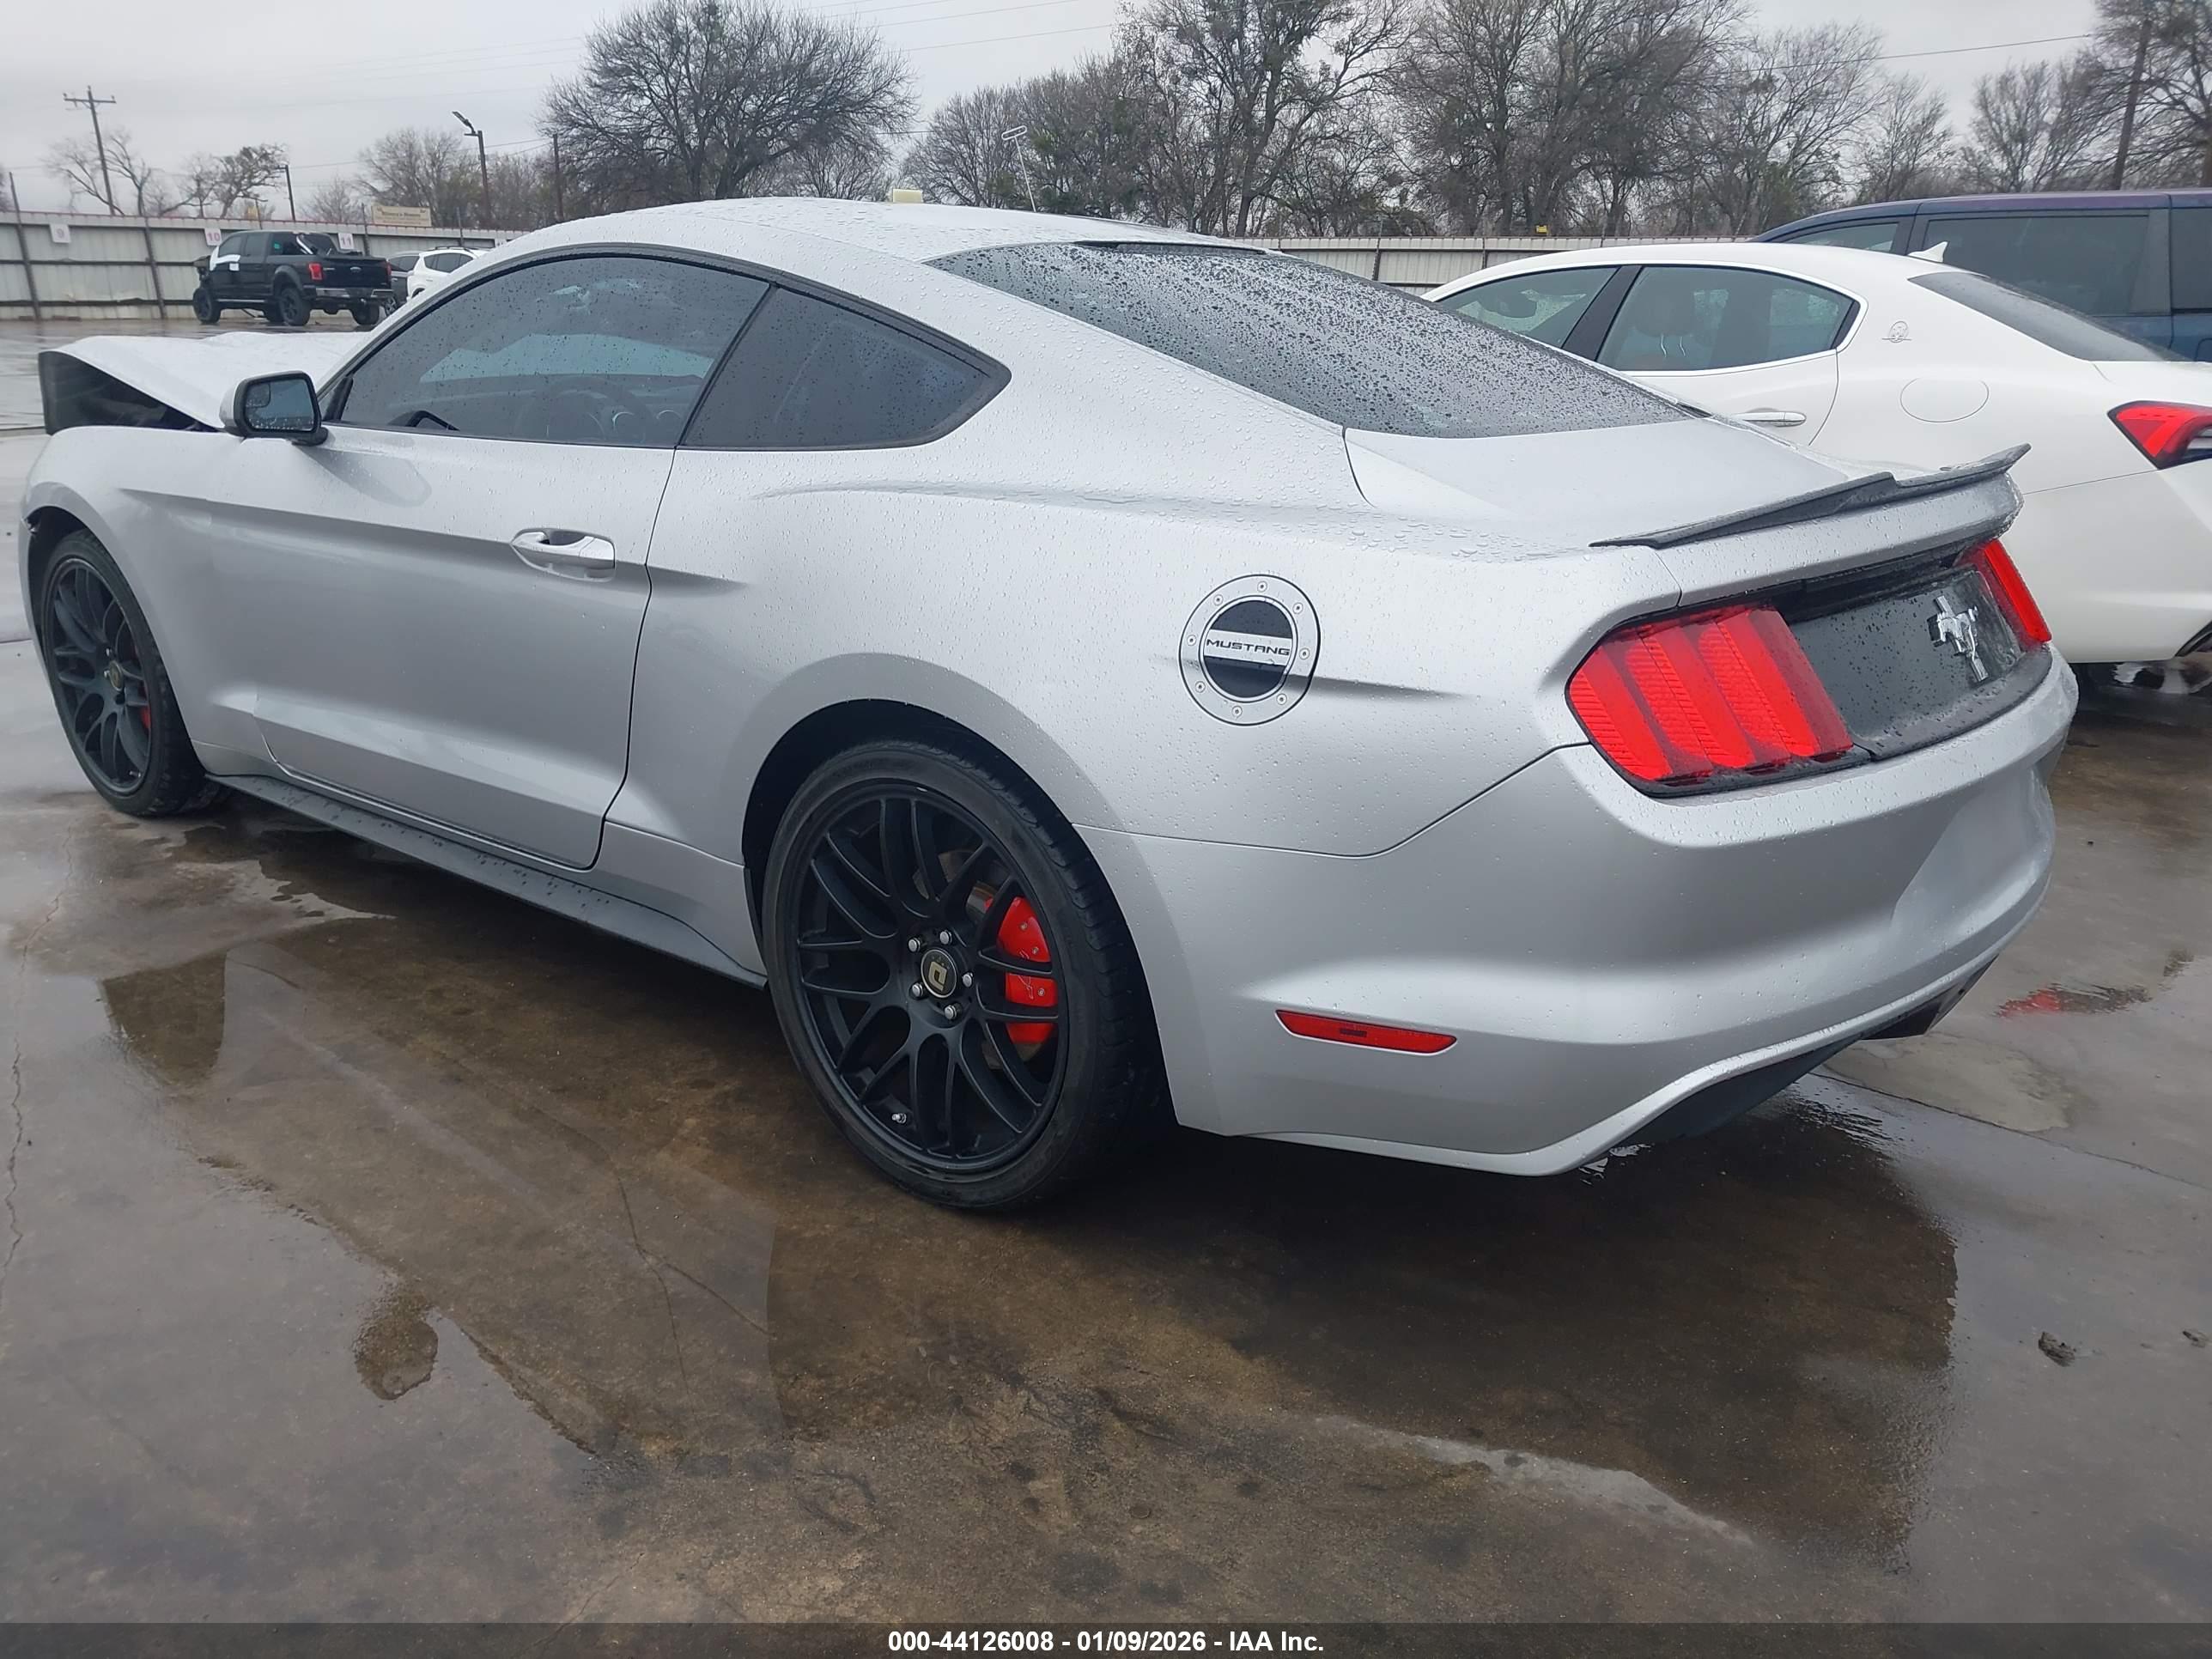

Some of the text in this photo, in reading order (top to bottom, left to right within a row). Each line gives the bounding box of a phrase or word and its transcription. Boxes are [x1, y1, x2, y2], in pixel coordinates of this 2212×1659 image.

[56, 228, 65, 240] 9
[206, 232, 221, 241] 10
[340, 236, 351, 246] 11
[1206, 638, 1291, 656] MUSTANG
